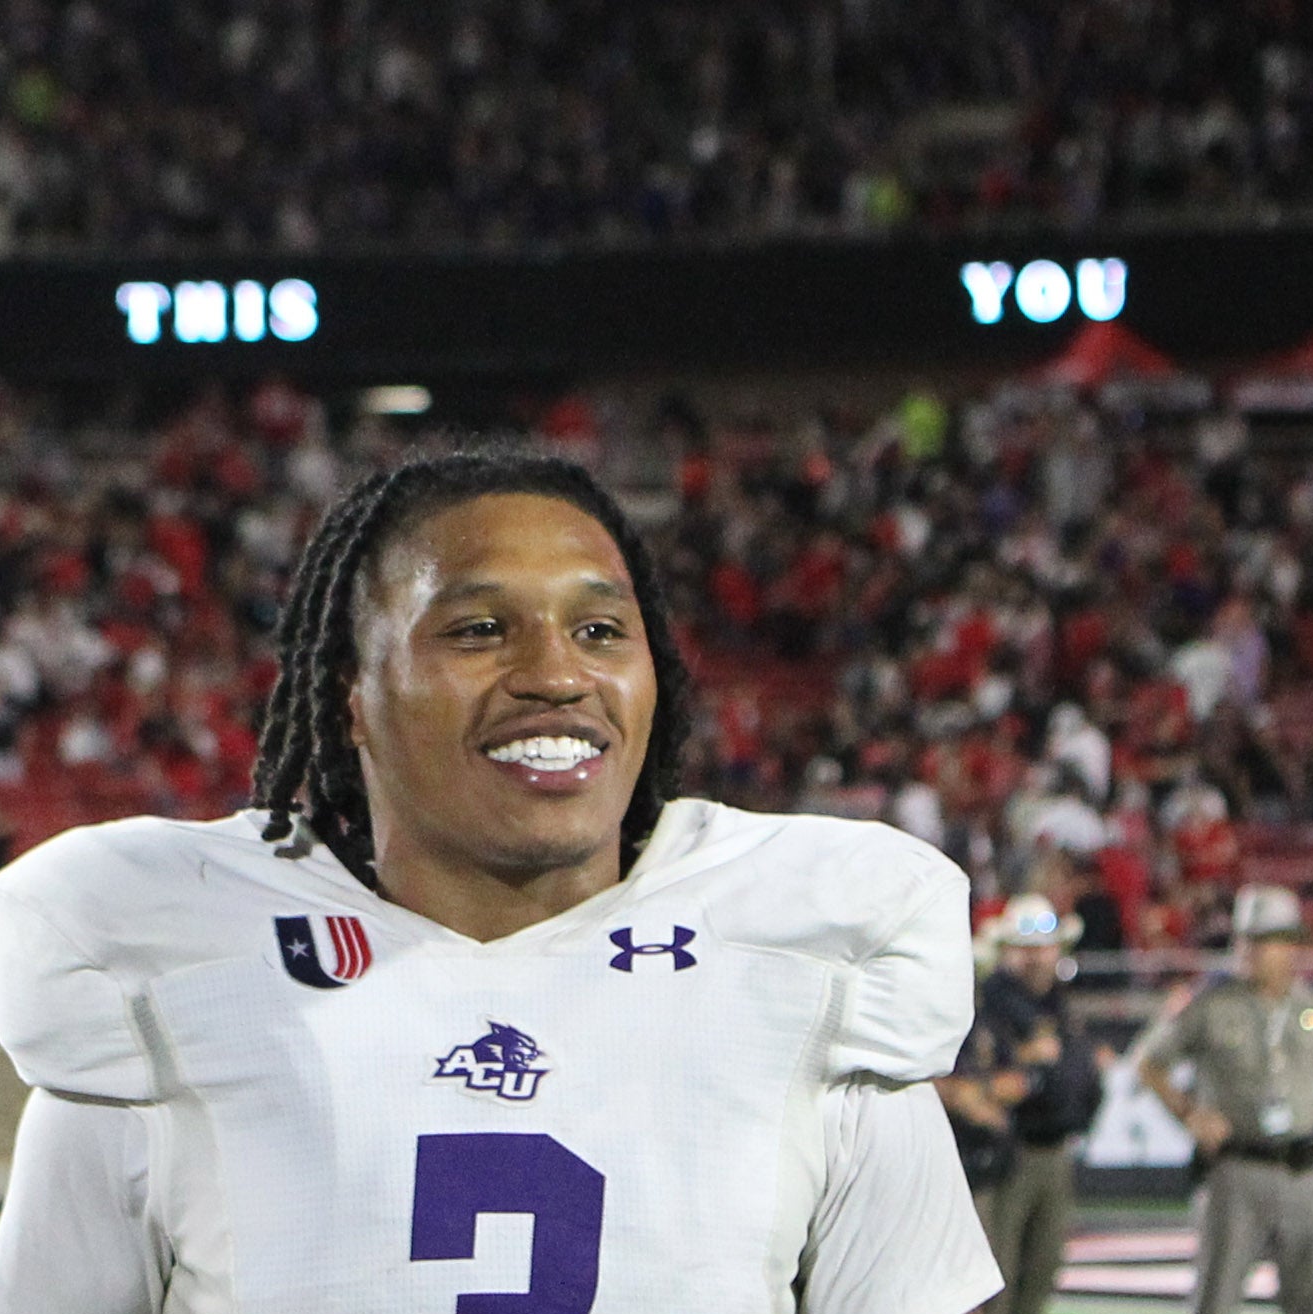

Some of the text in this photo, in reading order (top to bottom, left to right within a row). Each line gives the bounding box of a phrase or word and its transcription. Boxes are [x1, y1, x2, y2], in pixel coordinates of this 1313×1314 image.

[115, 278, 319, 344] THIS
[960, 257, 1128, 325] YOU
[433, 1042, 551, 1102] ACU
